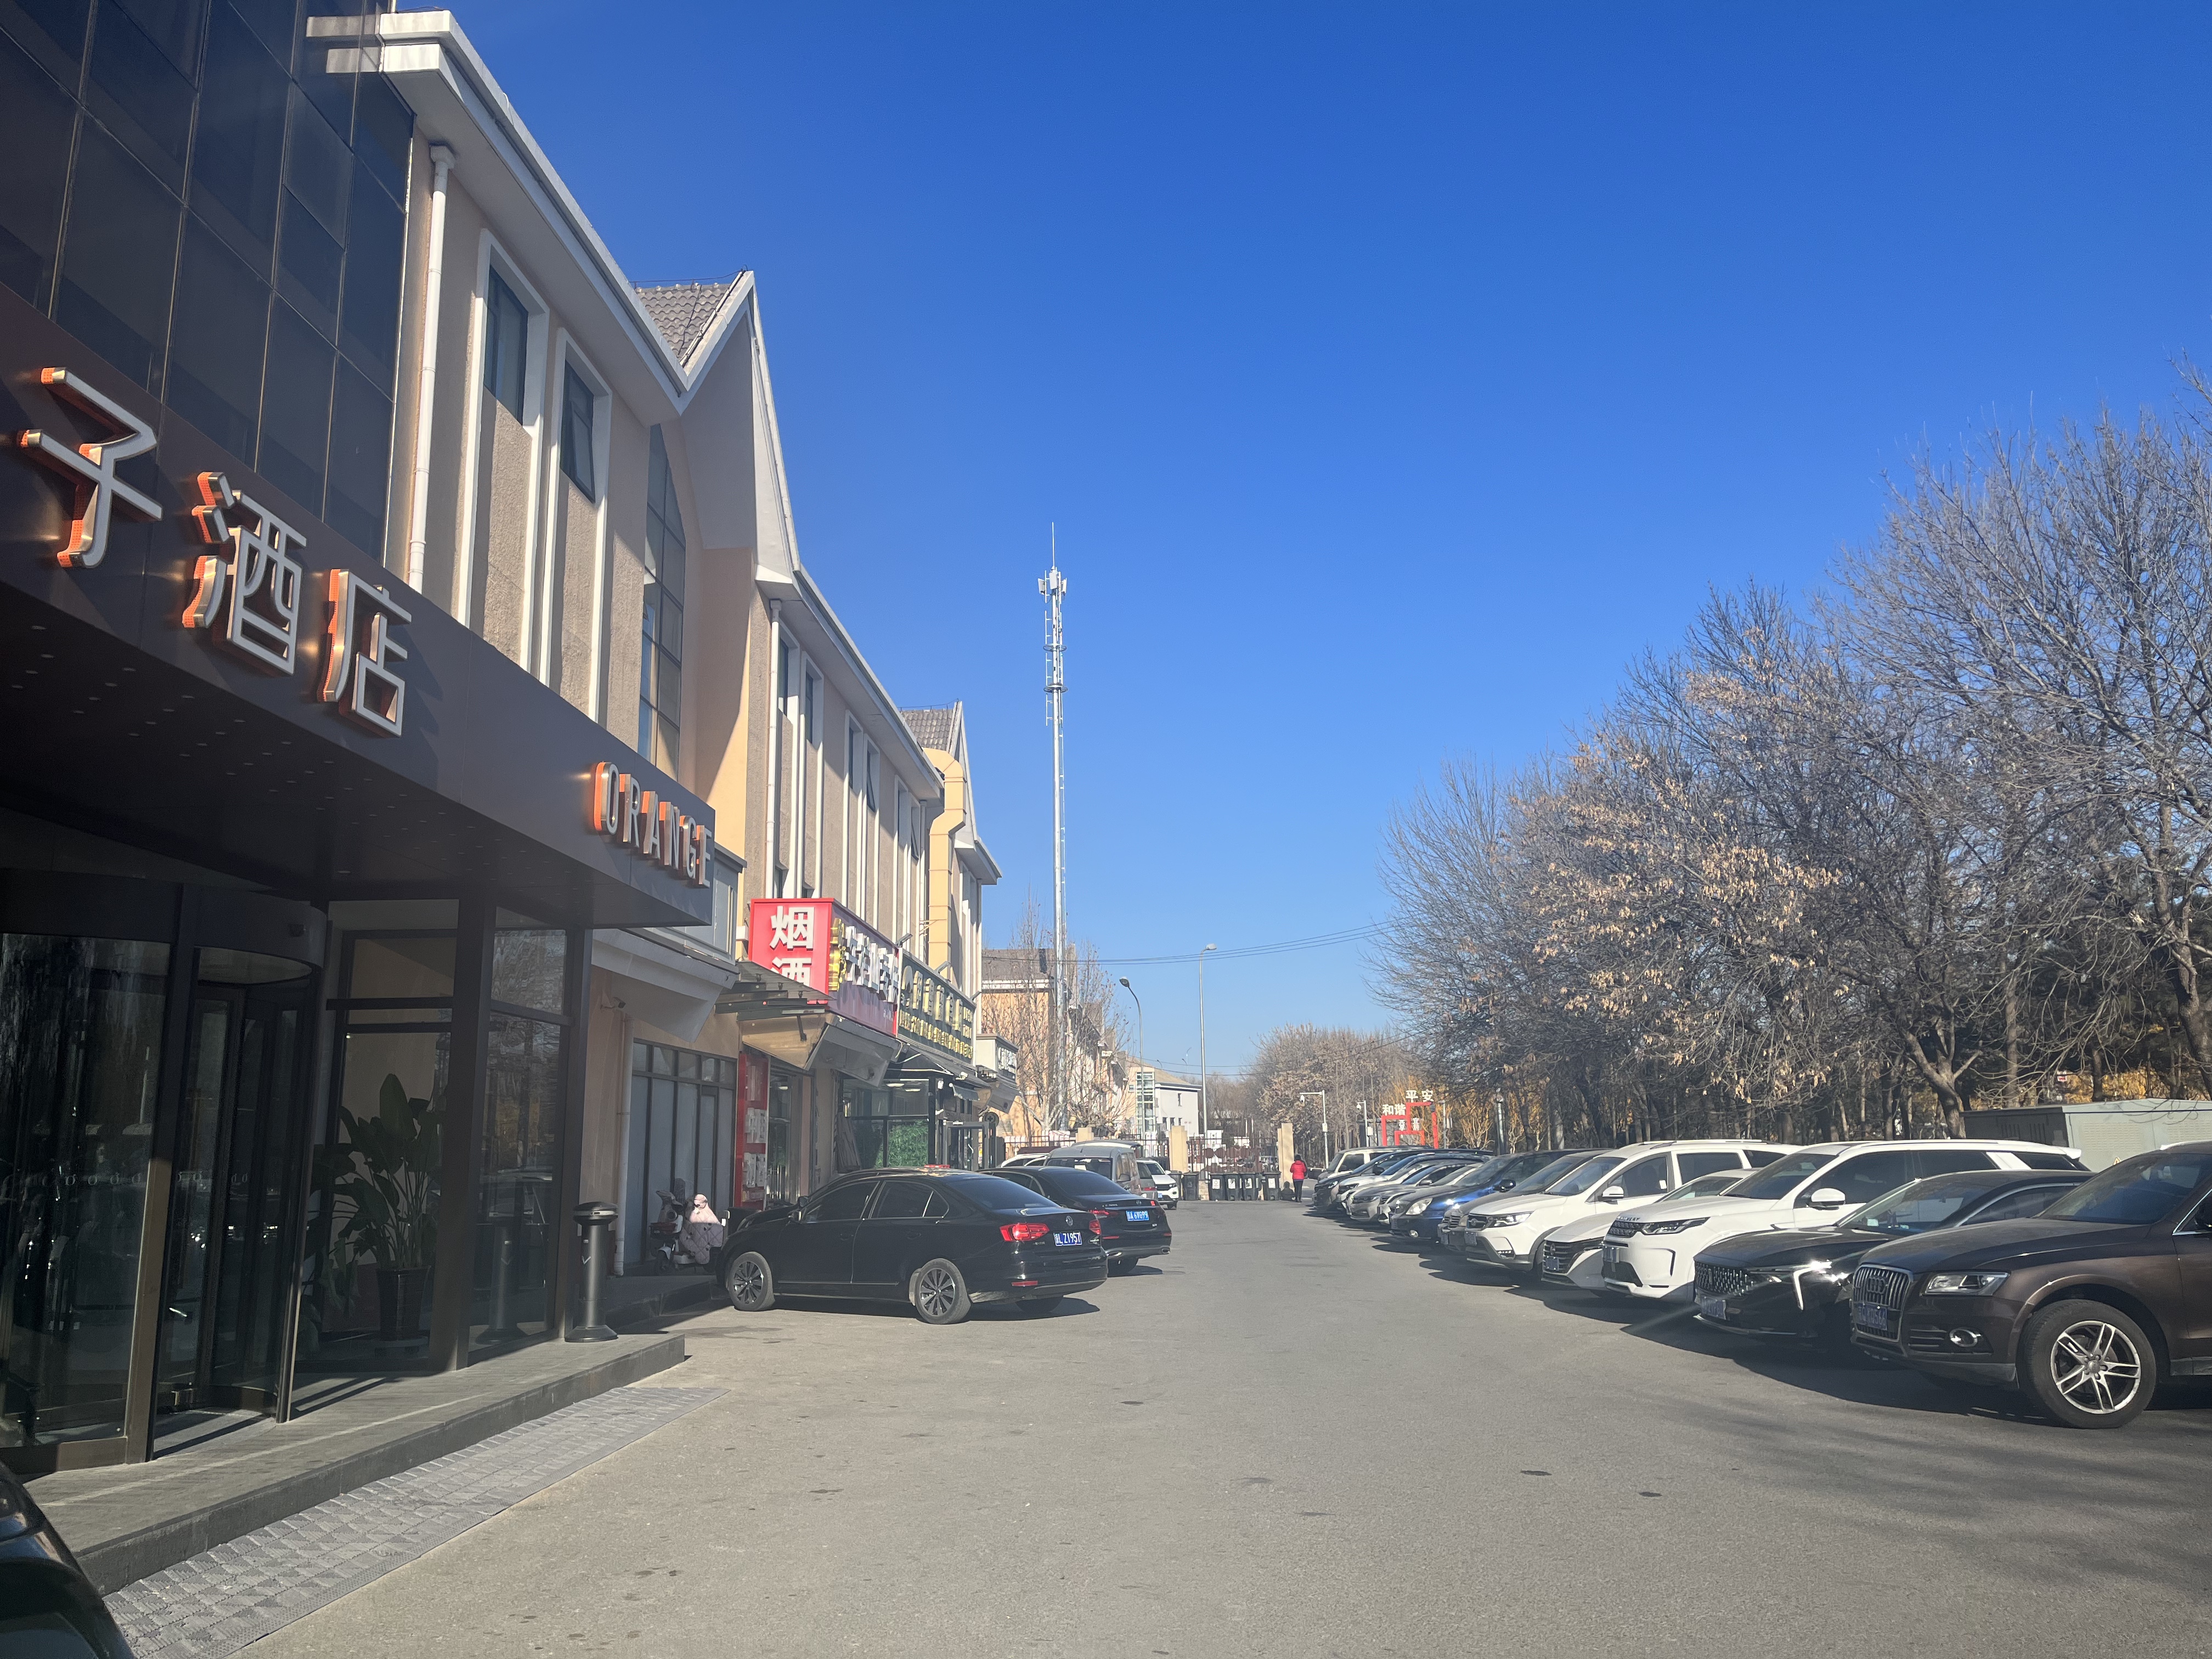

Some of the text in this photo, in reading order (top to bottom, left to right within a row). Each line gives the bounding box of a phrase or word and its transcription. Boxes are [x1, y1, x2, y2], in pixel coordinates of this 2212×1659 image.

[594, 761, 712, 888] ORANGE
[1405, 1089, 1434, 1103] 平安
[1382, 1103, 1406, 1116] 和谐
